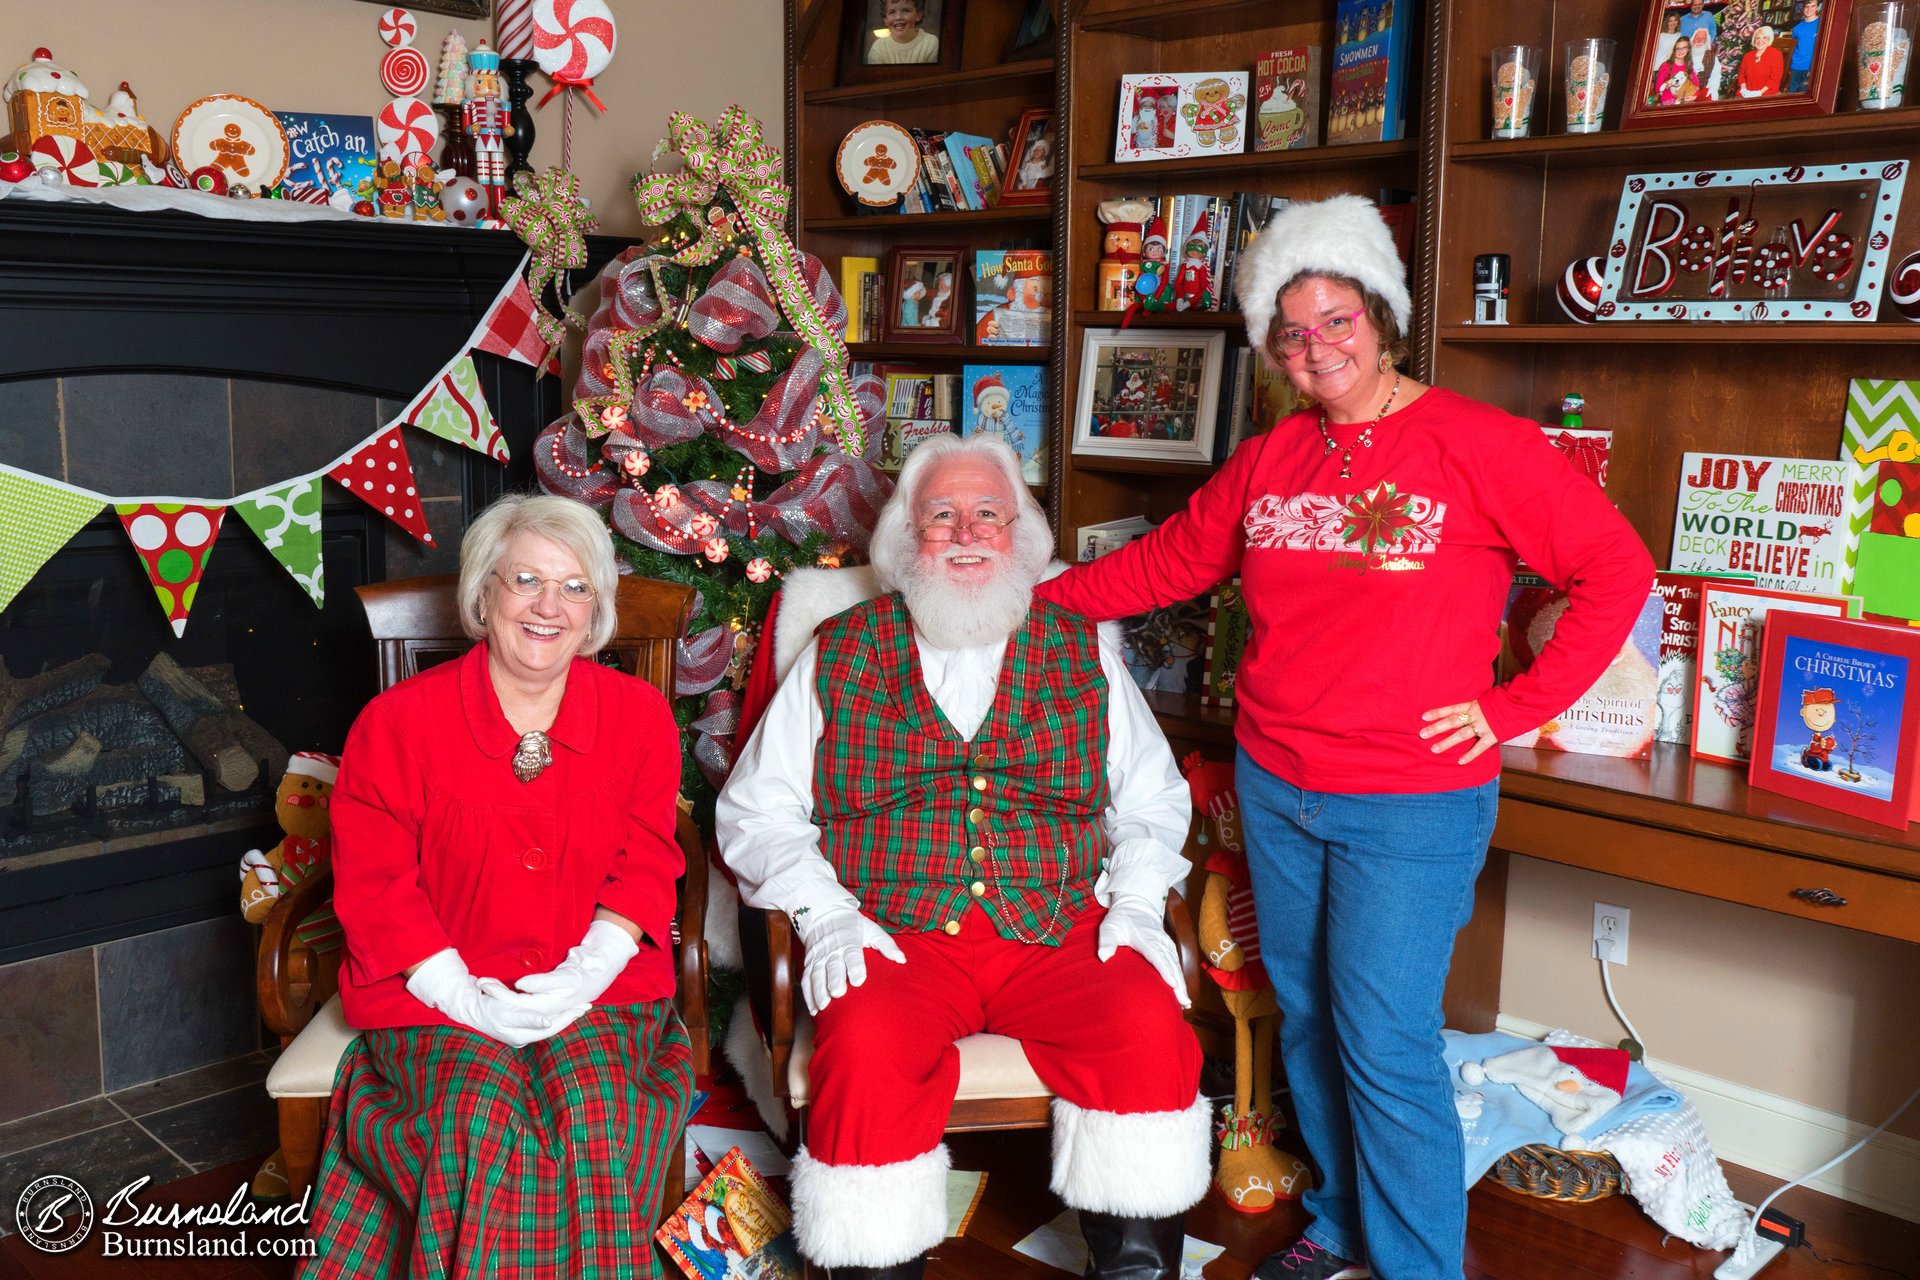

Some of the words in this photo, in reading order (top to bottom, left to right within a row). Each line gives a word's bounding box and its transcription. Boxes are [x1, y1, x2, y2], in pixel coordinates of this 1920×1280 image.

[1271, 50, 1293, 59] FRESH
[1340, 44, 1379, 66] SNOWMEN
[1257, 59, 1275, 77] HOT
[1277, 55, 1306, 75] COCOA
[292, 124, 339, 158] Catch
[344, 134, 368, 155] an
[1260, 120, 1292, 142] Come
[1631, 197, 1855, 297] Believe
[981, 261, 1003, 279] How
[1005, 256, 1033, 273] Santa
[1010, 399, 1048, 417] Christm
[1687, 457, 1773, 493] JOY
[1781, 463, 1847, 483] MERRY
[1682, 490, 1722, 511] To
[1720, 491, 1773, 514] The
[1775, 481, 1844, 518] CHRISTMAS
[1682, 512, 1798, 541] WORLD
[1679, 535, 1728, 556] DECK
[1328, 552, 1367, 576] Merry
[1369, 553, 1425, 572] Christmas
[1728, 540, 1811, 578] BELIEVE
[1813, 554, 1835, 579] in
[1678, 588, 1699, 600] The
[1708, 601, 1754, 619] Fancy
[1670, 617, 1698, 632] STOL
[1660, 630, 1698, 648] HRIST
[1815, 651, 1822, 659] A
[1822, 652, 1850, 664] CHARLIE
[1852, 658, 1876, 669] BROWN
[1795, 656, 1895, 689] CHRISTMAS
[1595, 696, 1629, 709] Spirit
[1629, 699, 1644, 709] of
[1557, 705, 1644, 727] hristmas
